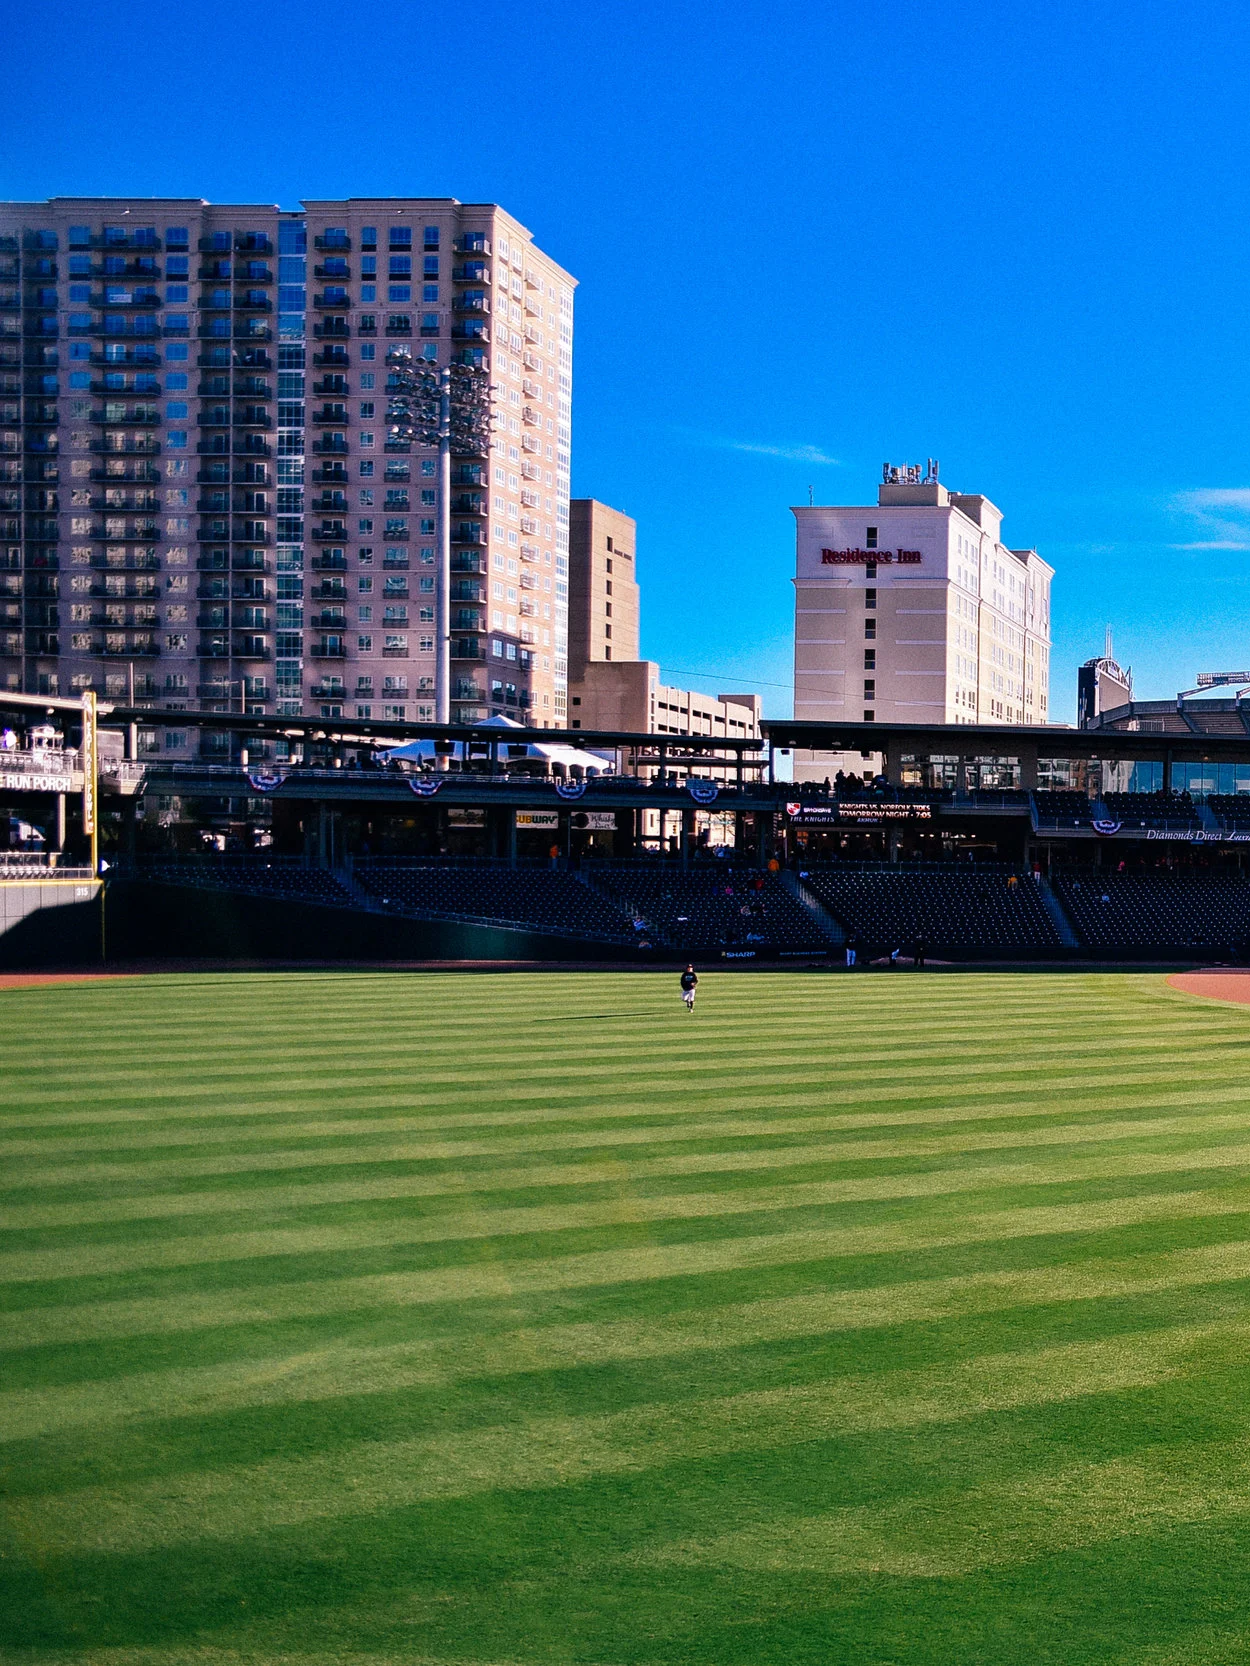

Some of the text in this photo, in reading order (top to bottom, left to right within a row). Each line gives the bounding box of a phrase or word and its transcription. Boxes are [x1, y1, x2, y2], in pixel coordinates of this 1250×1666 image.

[821, 548, 921, 564] Residence Inn
[7, 775, 30, 789] RUN
[33, 777, 71, 791] PORCH
[839, 803, 868, 811] KNIGHTS
[913, 804, 931, 812] TIDES
[839, 810, 885, 818] TOMORROW
[886, 811, 909, 819] NIGHT
[915, 811, 932, 819] 7:05
[1146, 829, 1194, 841] Diamonds
[1195, 830, 1222, 841] Direct
[76, 887, 89, 896] 315
